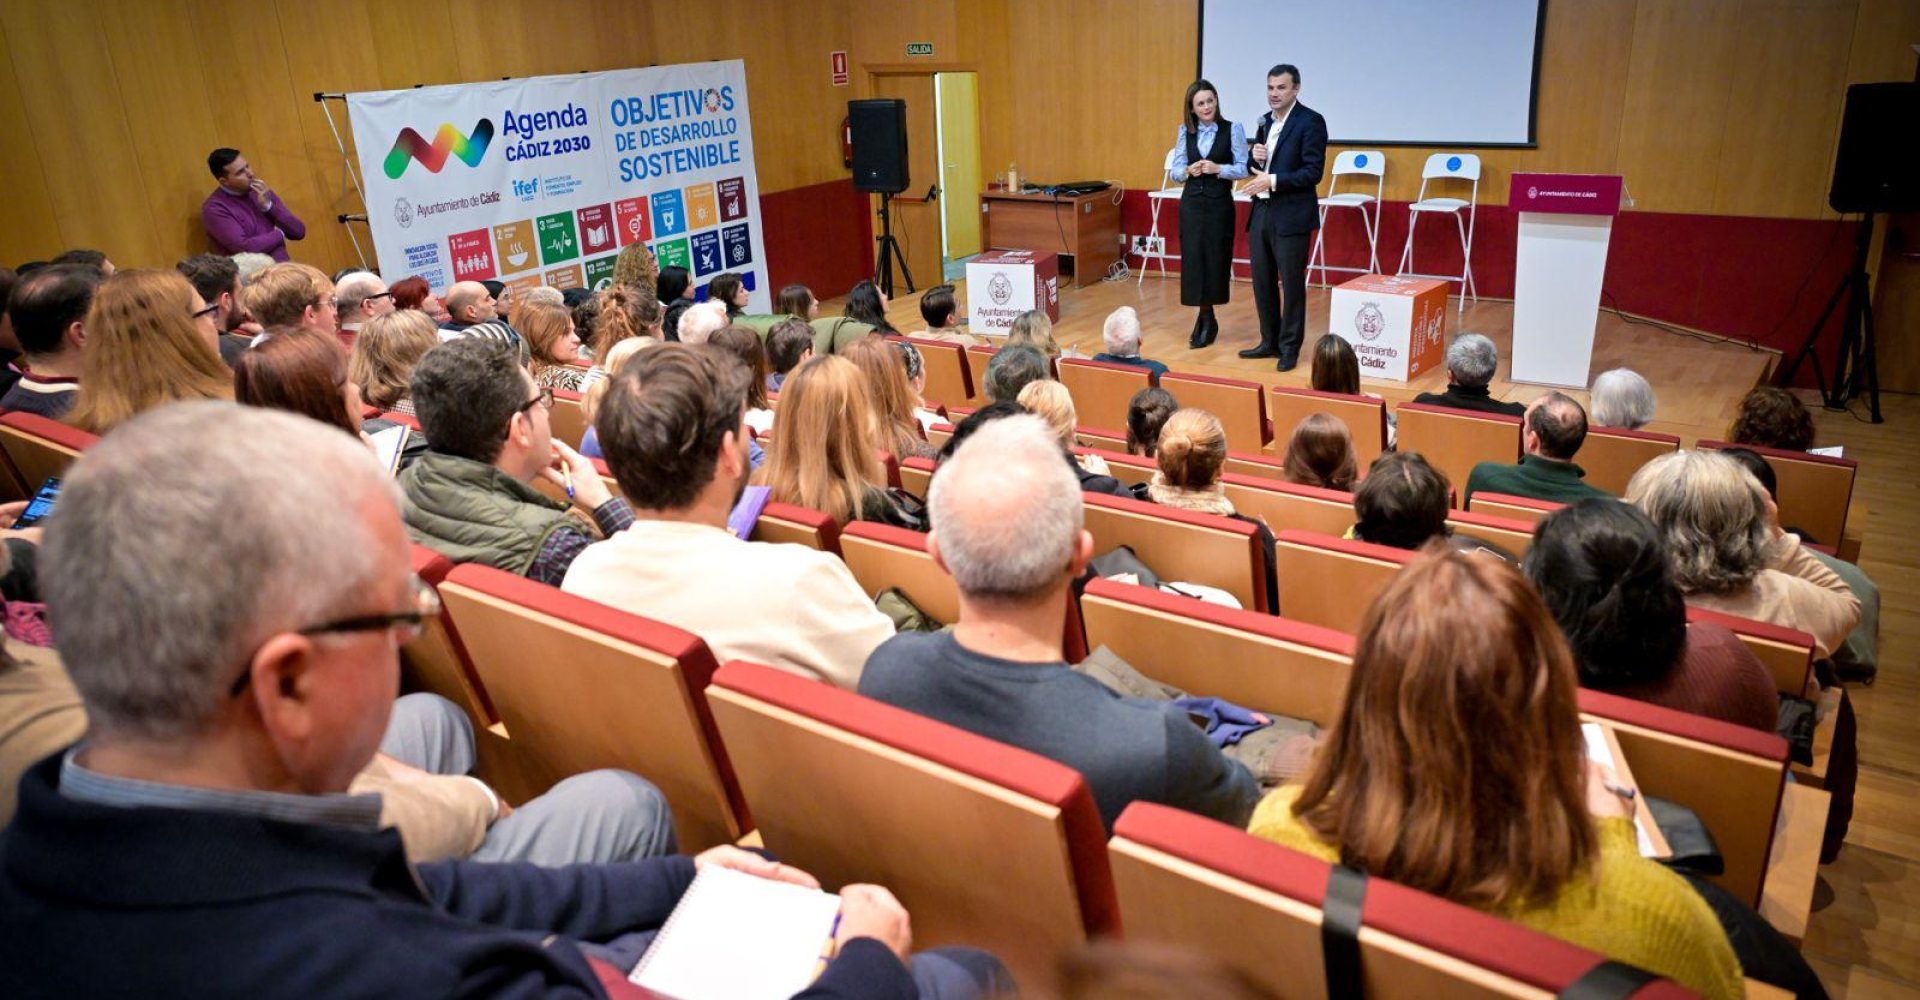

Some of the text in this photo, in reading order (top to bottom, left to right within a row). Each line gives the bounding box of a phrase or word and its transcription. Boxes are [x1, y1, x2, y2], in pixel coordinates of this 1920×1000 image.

[907, 45, 932, 54] SALIDA
[610, 85, 734, 127] OBJETIVOS
[503, 102, 587, 140] Agenda
[615, 117, 737, 152] DE DESARROLLO
[505, 135, 591, 161] CÁDIZ 2030
[619, 140, 741, 182] SOSTENIBLE
[512, 178, 538, 196] ifef
[417, 191, 500, 218] Ayuntamiento de Cádiz
[617, 204, 622, 214] 5
[580, 211, 585, 222] 4
[540, 220, 546, 231] 3
[496, 230, 503, 240] 2
[723, 230, 729, 240] 17
[451, 239, 456, 250] 1
[985, 319, 995, 327] de
[1361, 355, 1386, 369] Cádiz
